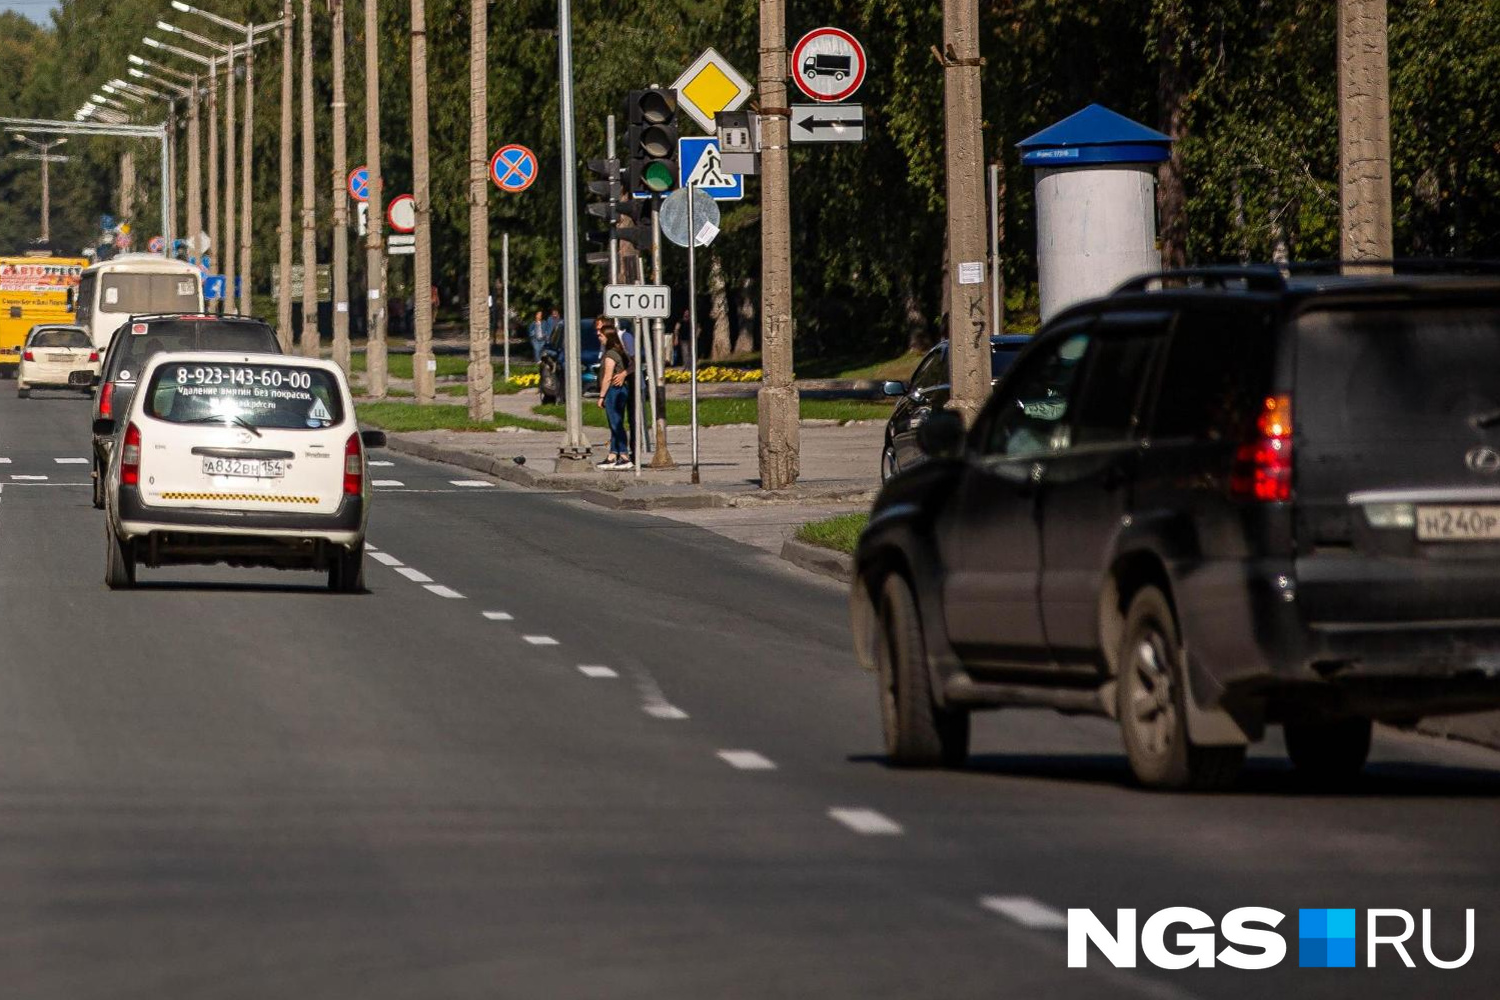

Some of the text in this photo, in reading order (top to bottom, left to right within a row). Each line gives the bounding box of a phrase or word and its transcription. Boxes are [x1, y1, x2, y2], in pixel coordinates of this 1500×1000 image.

[609, 293, 665, 309] СТОП
[177, 367, 311, 388] 8-923-143-60-00
[178, 386, 218, 396] Удаление
[220, 389, 251, 397] вмятин
[254, 388, 269, 397] без
[315, 408, 325, 418] Ш
[207, 459, 282, 475] А832ВН 154
